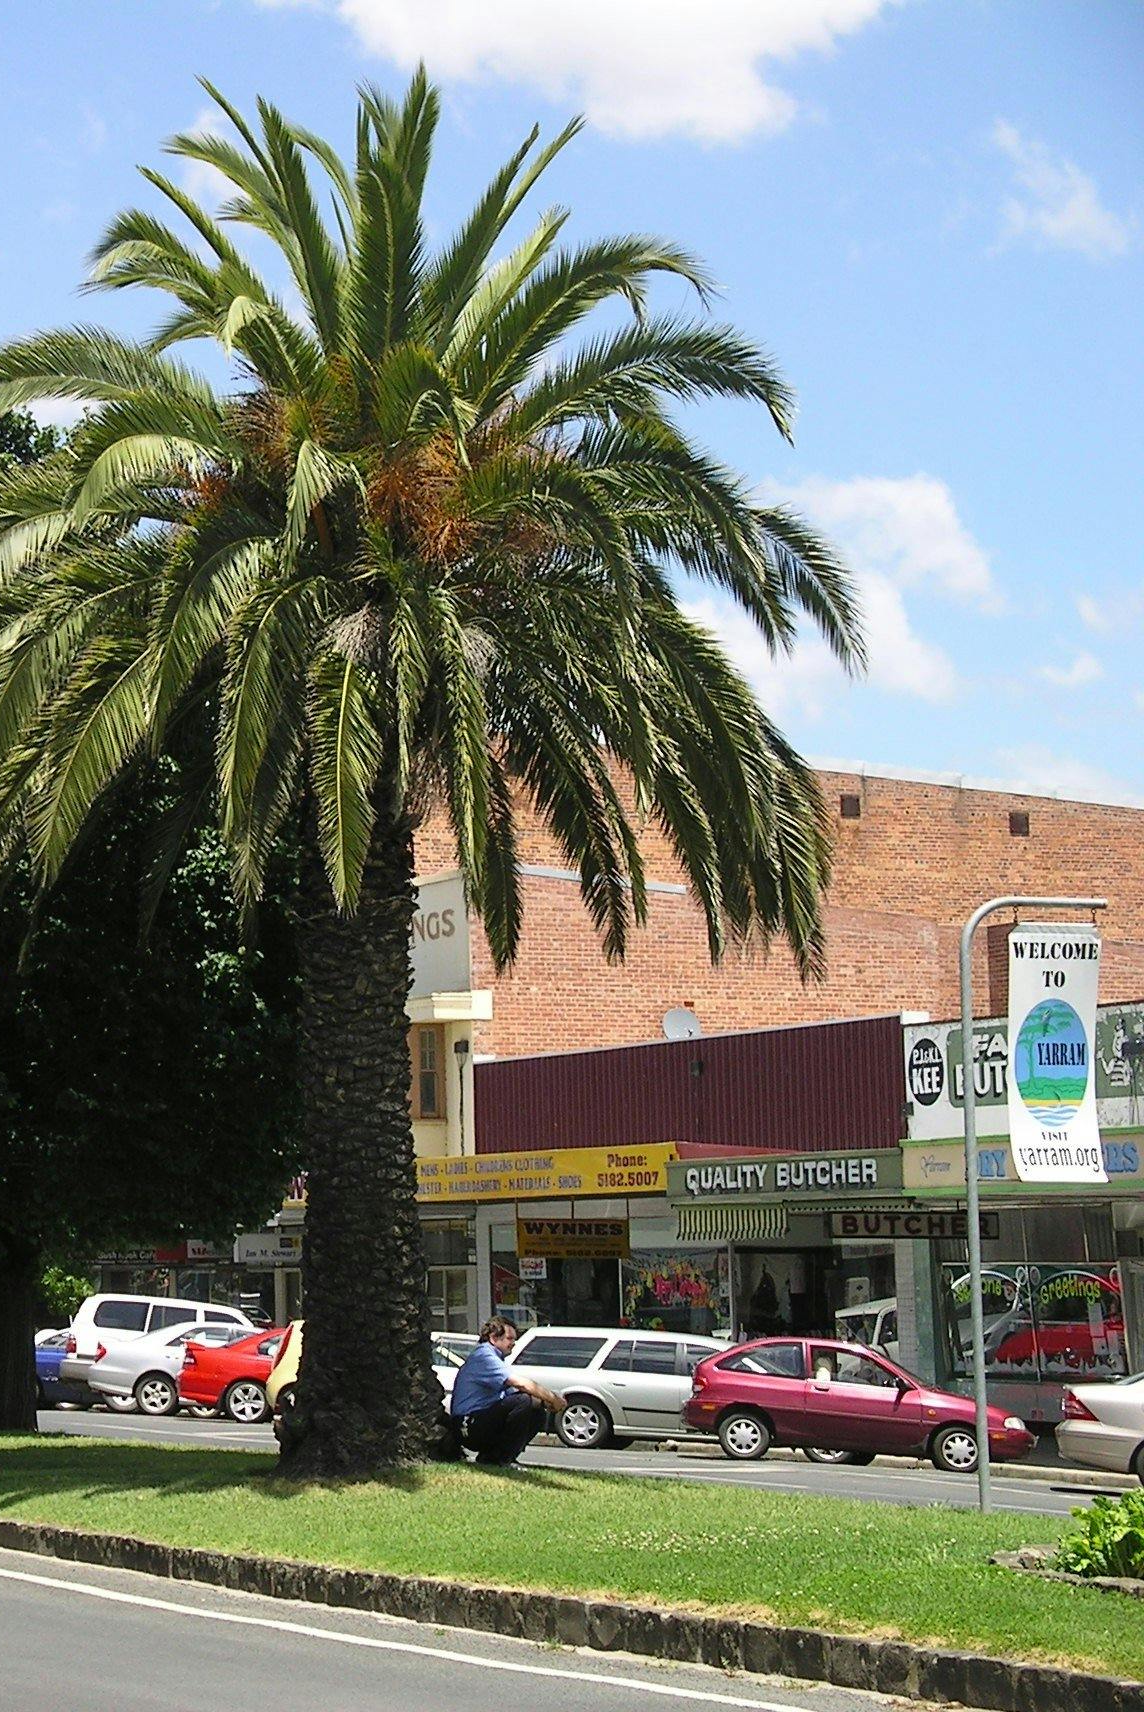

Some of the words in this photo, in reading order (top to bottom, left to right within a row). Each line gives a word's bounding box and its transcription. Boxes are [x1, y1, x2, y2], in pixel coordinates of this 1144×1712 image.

[412, 909, 456, 942] NGS
[1012, 942, 1099, 960] WELCOME
[1042, 970, 1066, 987] TO
[1037, 1042, 1086, 1066] YARRAM
[912, 1066, 941, 1095] KEE
[1041, 1131, 1068, 1141] VISIT
[514, 1156, 554, 1172] CLOTHING
[606, 1153, 648, 1168] Phone:
[1018, 1143, 1100, 1173] yarram.org
[508, 1176, 550, 1191] MATERIALS
[558, 1174, 582, 1189] SHOES
[596, 1170, 659, 1188] 5182.5007
[686, 1163, 768, 1195] QUALITY
[775, 1157, 879, 1188] BUTCHER
[523, 1222, 623, 1236] WYNNES
[841, 1214, 992, 1236] BUTCHER
